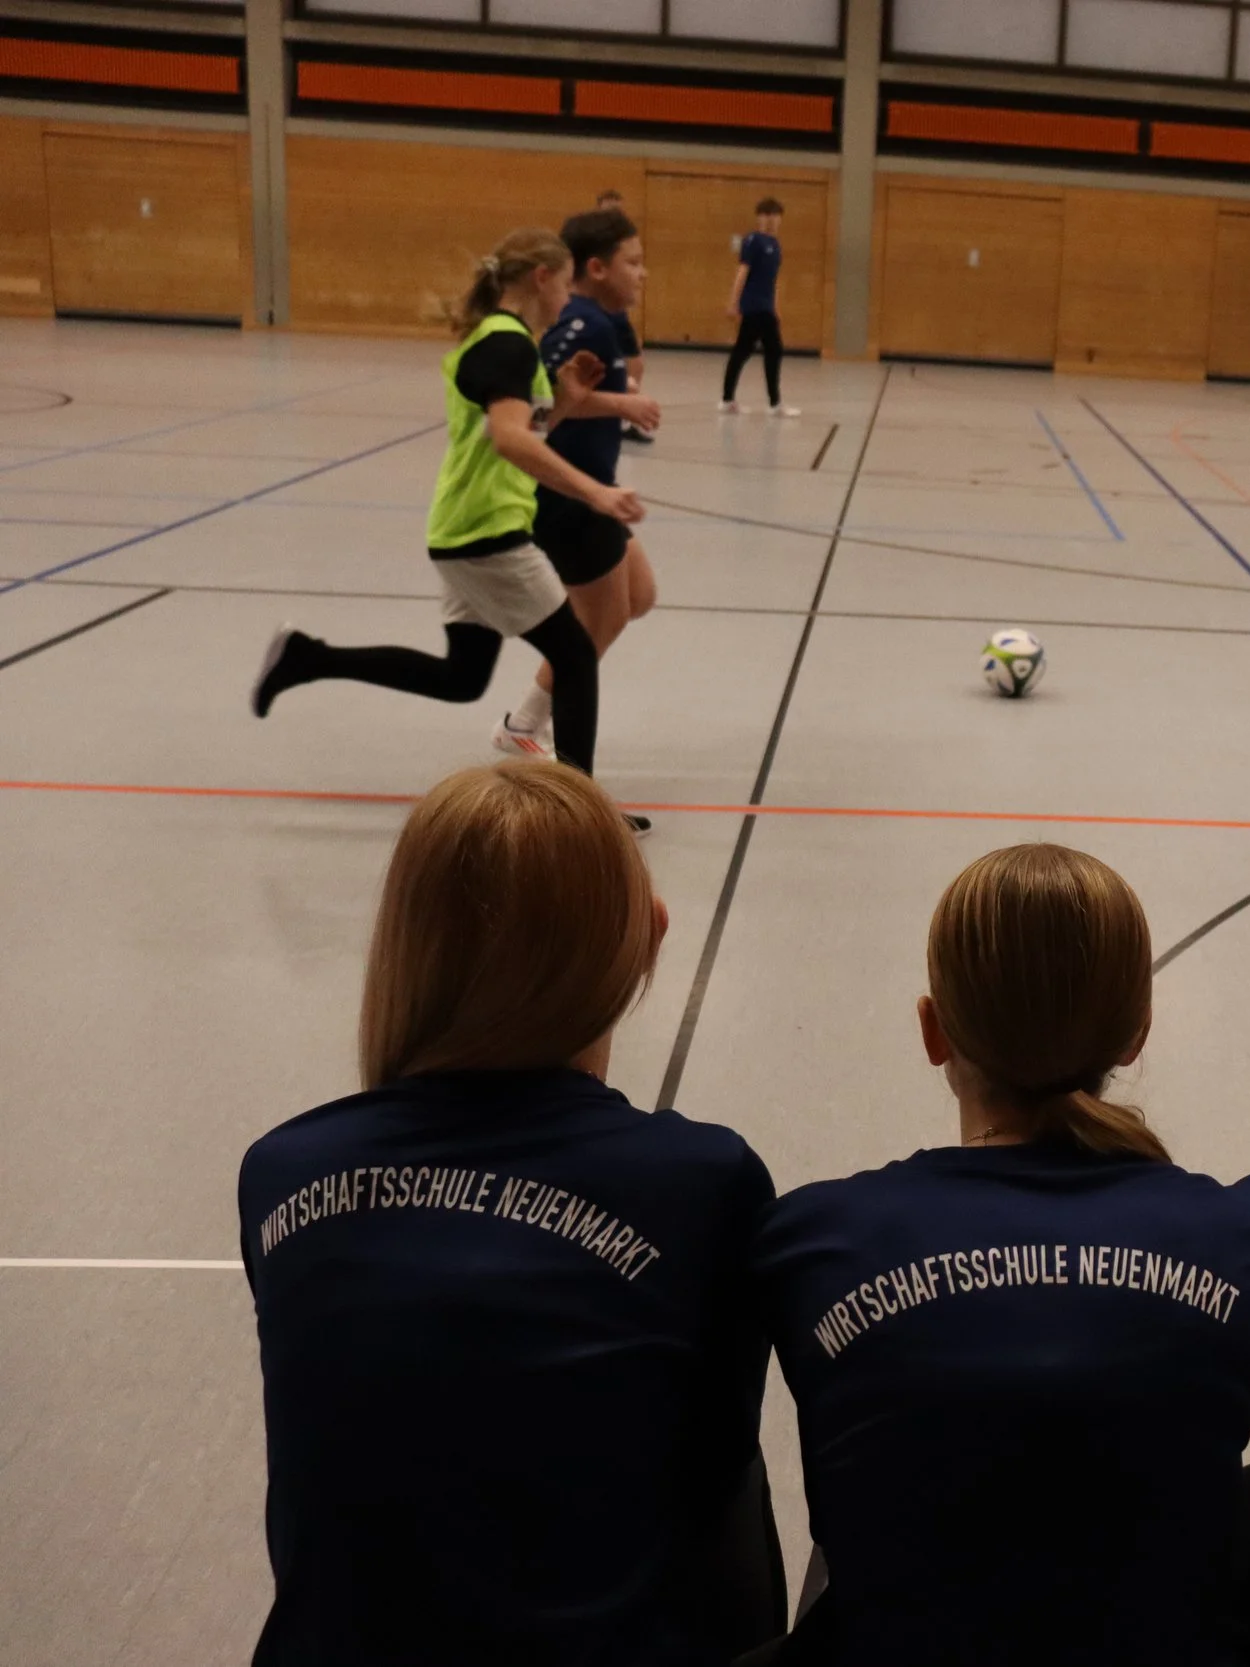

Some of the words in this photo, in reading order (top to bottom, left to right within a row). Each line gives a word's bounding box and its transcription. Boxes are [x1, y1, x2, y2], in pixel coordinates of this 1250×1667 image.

[260, 1166, 497, 1257] WIRTSCHAFTSSCHULE
[493, 1176, 661, 1281] NEUENMARKT
[814, 1244, 1069, 1359] WIRTSCHAFTSSCHULE
[1078, 1245, 1240, 1324] NEUENMARKT
